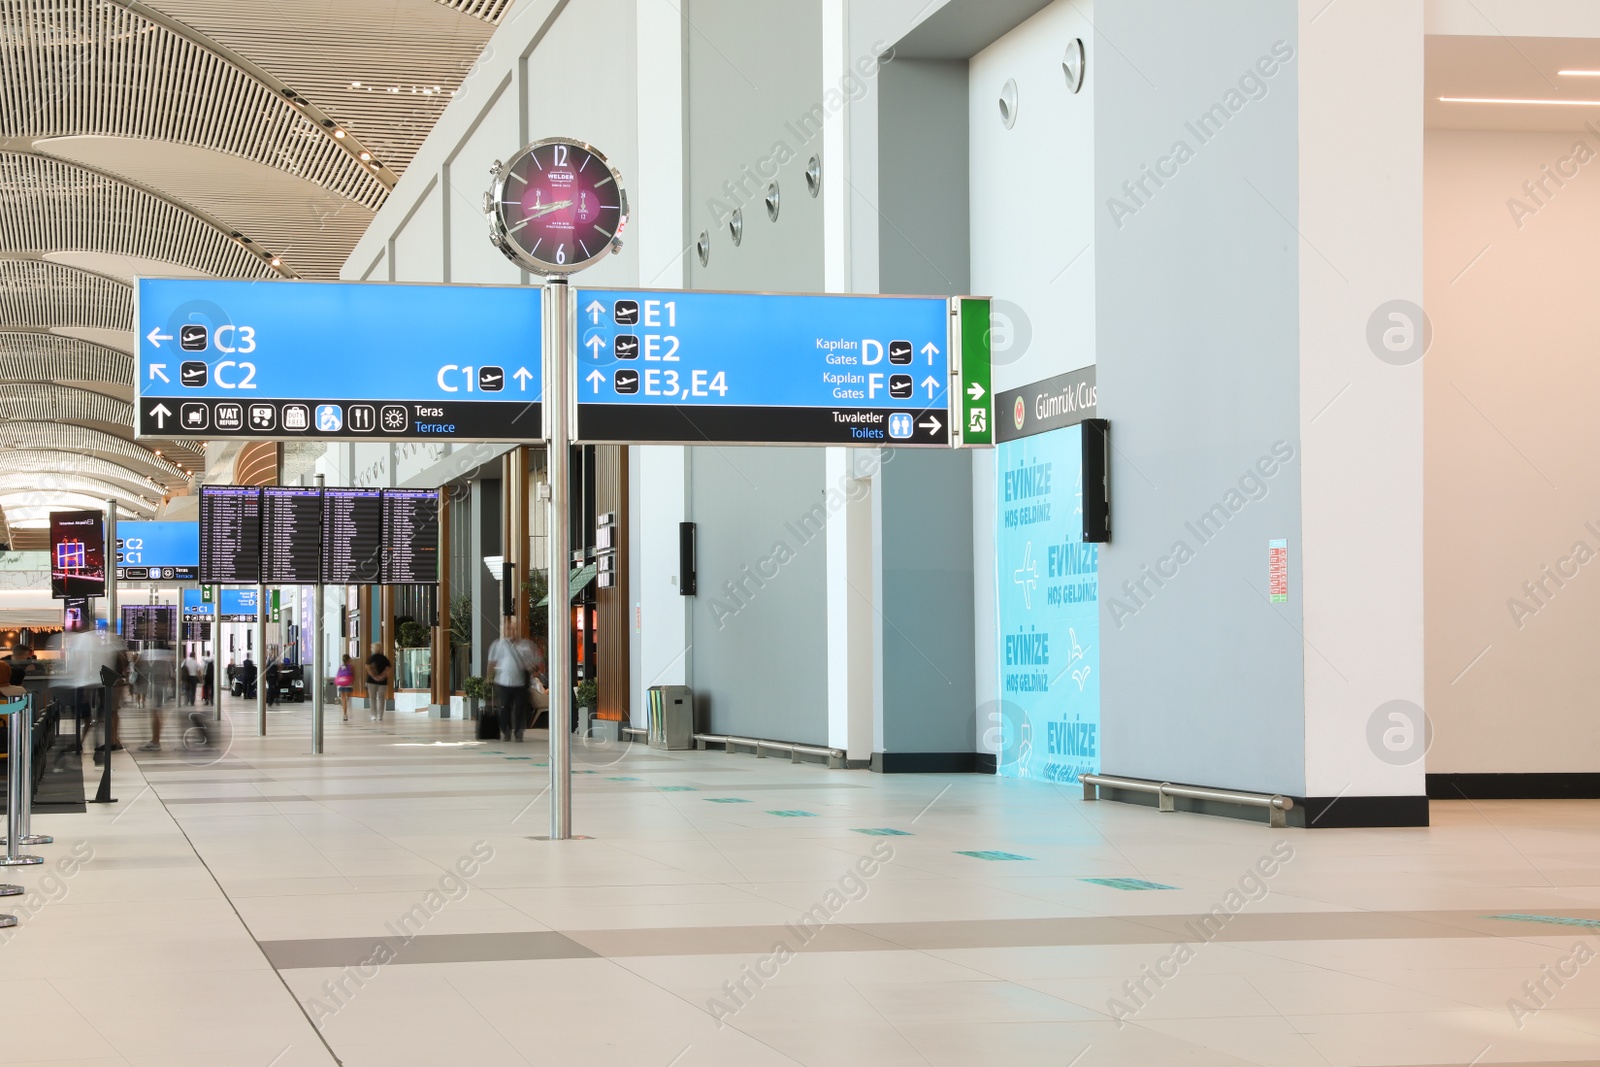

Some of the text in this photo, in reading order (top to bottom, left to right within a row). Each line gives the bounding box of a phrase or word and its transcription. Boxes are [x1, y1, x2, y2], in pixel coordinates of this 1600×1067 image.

[554, 145, 568, 167] 12
[548, 173, 575, 181] WELDER
[556, 243, 566, 265] 6
[645, 300, 675, 326] E1
[214, 325, 256, 353] C3
[645, 335, 679, 361] E2
[816, 338, 858, 352] Kapıları
[825, 353, 858, 365] Gates
[862, 339, 883, 365] D
[214, 361, 256, 388] C2
[437, 365, 473, 392] C1
[645, 369, 728, 400] E3,E4
[823, 372, 865, 386] Kapıları
[869, 374, 883, 398] F
[832, 387, 865, 399] Gates
[219, 408, 238, 419] VAT
[414, 405, 444, 417] Teras
[832, 411, 884, 424] Tuvaletler
[414, 421, 456, 433] Terrace
[850, 427, 884, 439] Toilets
[1005, 457, 1052, 502] EVİNİZE
[1005, 498, 1051, 530] HOŞ GELDİNİZ
[126, 538, 143, 550] C2
[1048, 533, 1098, 578] EVİNİZE
[126, 552, 142, 563] C1
[1048, 578, 1097, 608] HOŞ GELDİNİZ
[198, 605, 208, 613] C1
[1006, 625, 1049, 666] EVİNİZE
[1006, 669, 1049, 695] HOŞ GELDİNİZ
[1048, 713, 1096, 758] EVİNİZE
